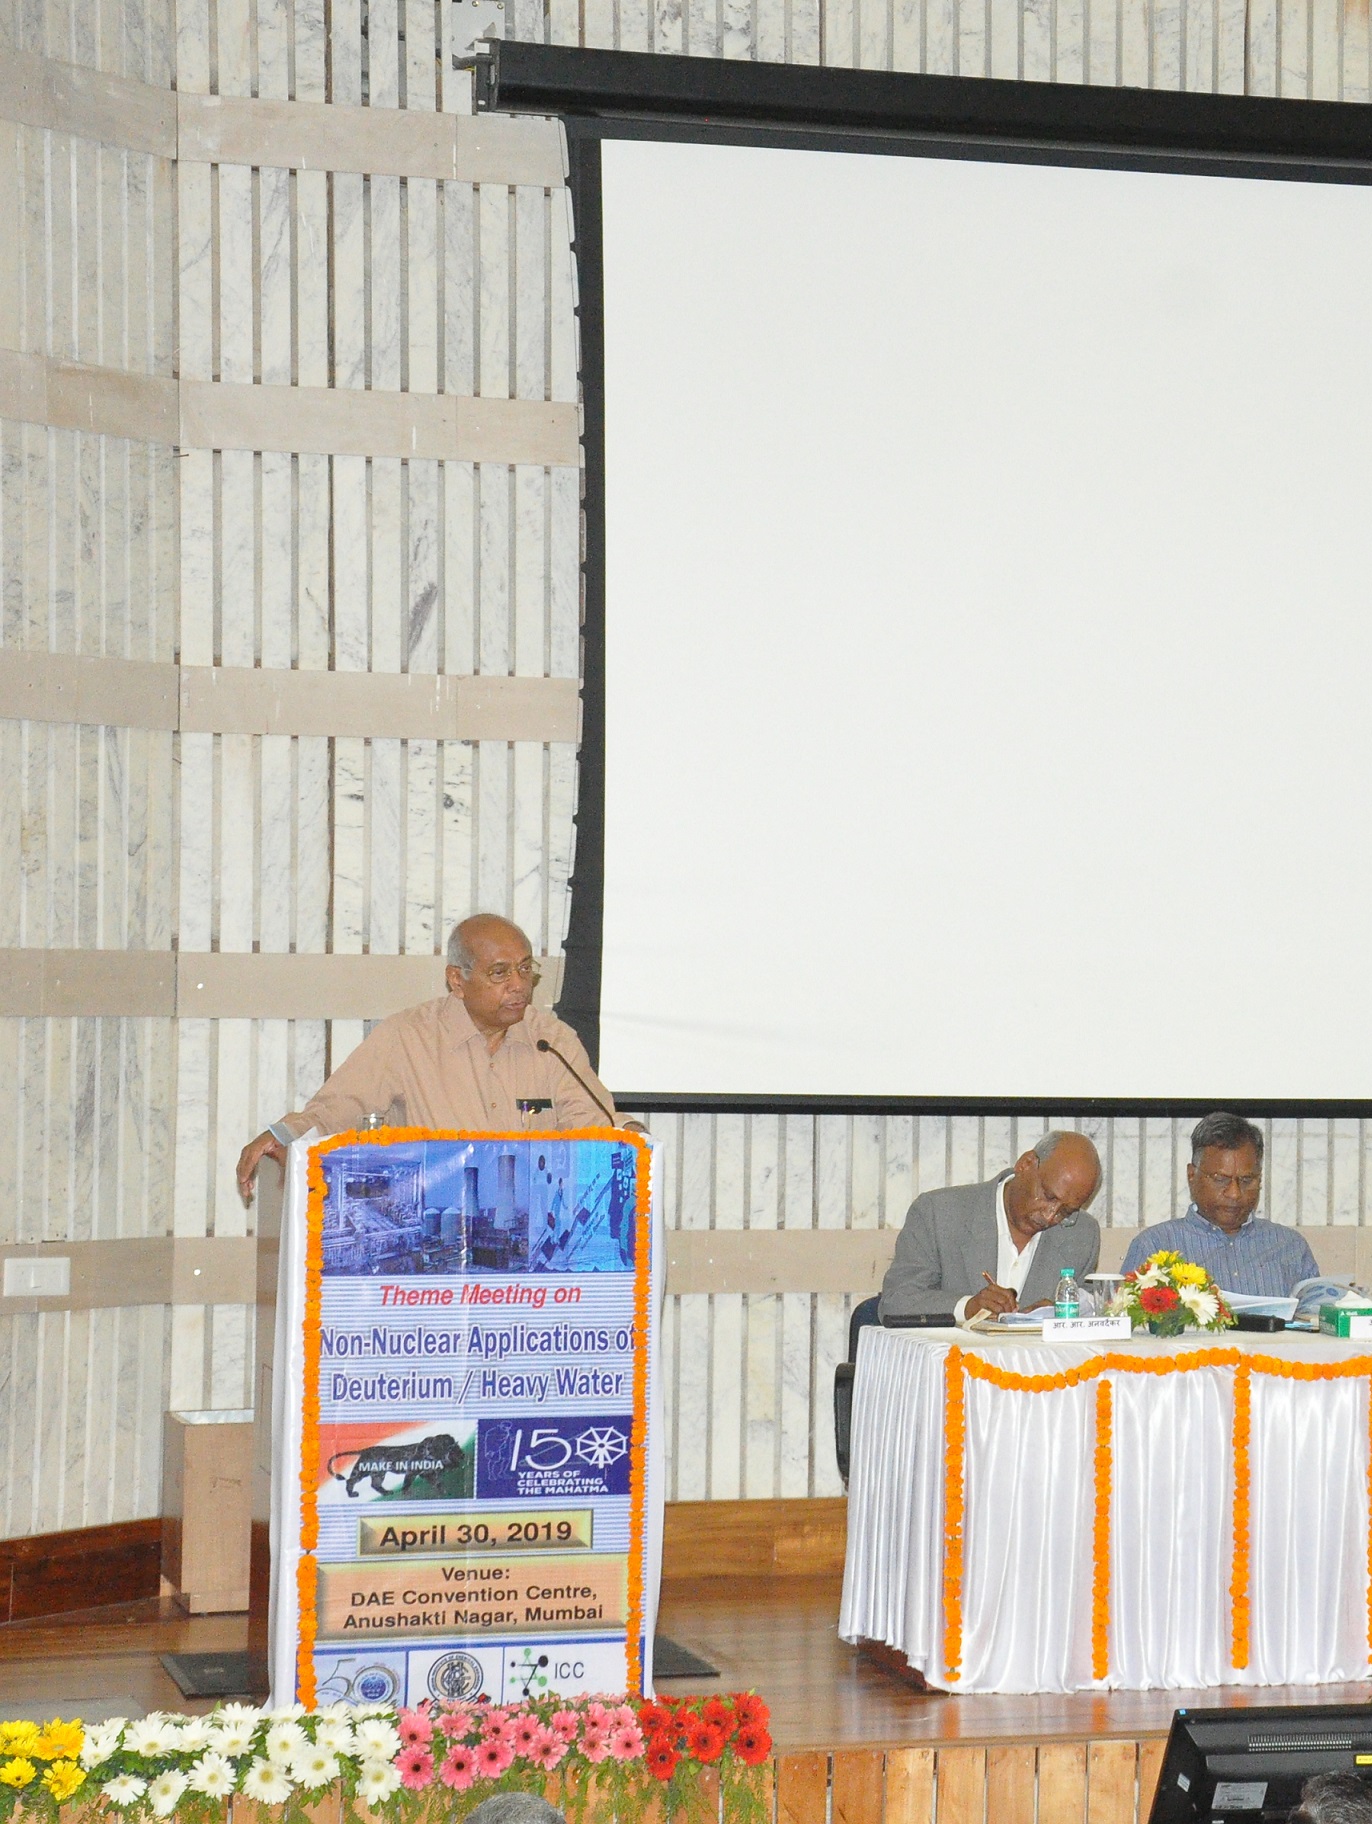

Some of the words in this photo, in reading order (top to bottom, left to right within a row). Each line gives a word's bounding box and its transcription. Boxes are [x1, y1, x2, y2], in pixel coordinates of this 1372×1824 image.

[380, 1285, 454, 1306] Theme
[460, 1283, 547, 1309] Meeting
[553, 1287, 581, 1303] on
[320, 1327, 461, 1356] Non-Nuclear
[467, 1323, 609, 1359] Applications
[333, 1371, 453, 1401] Deuterium
[458, 1371, 474, 1404] /
[482, 1370, 549, 1402] Heavy
[556, 1367, 623, 1395] Water
[358, 1461, 393, 1472] MAKE
[395, 1461, 408, 1471] IN
[410, 1459, 444, 1470] INDIA
[518, 1470, 560, 1479] YEARS
[563, 1470, 581, 1478] OF
[517, 1477, 603, 1487] CELEBRATING
[517, 1487, 542, 1495] THE
[545, 1485, 609, 1494] MAHATMA
[380, 1525, 446, 1550] April
[457, 1523, 497, 1547] 30,
[507, 1521, 572, 1542] 2019
[441, 1567, 510, 1581] Venue:
[351, 1591, 395, 1607] DAE
[402, 1587, 518, 1605] Convention
[526, 1585, 597, 1600] Centre,
[343, 1610, 446, 1629] Anushakti
[454, 1609, 518, 1627] Nagar,
[525, 1604, 603, 1621] Mumbai
[554, 1661, 585, 1679] ICC
